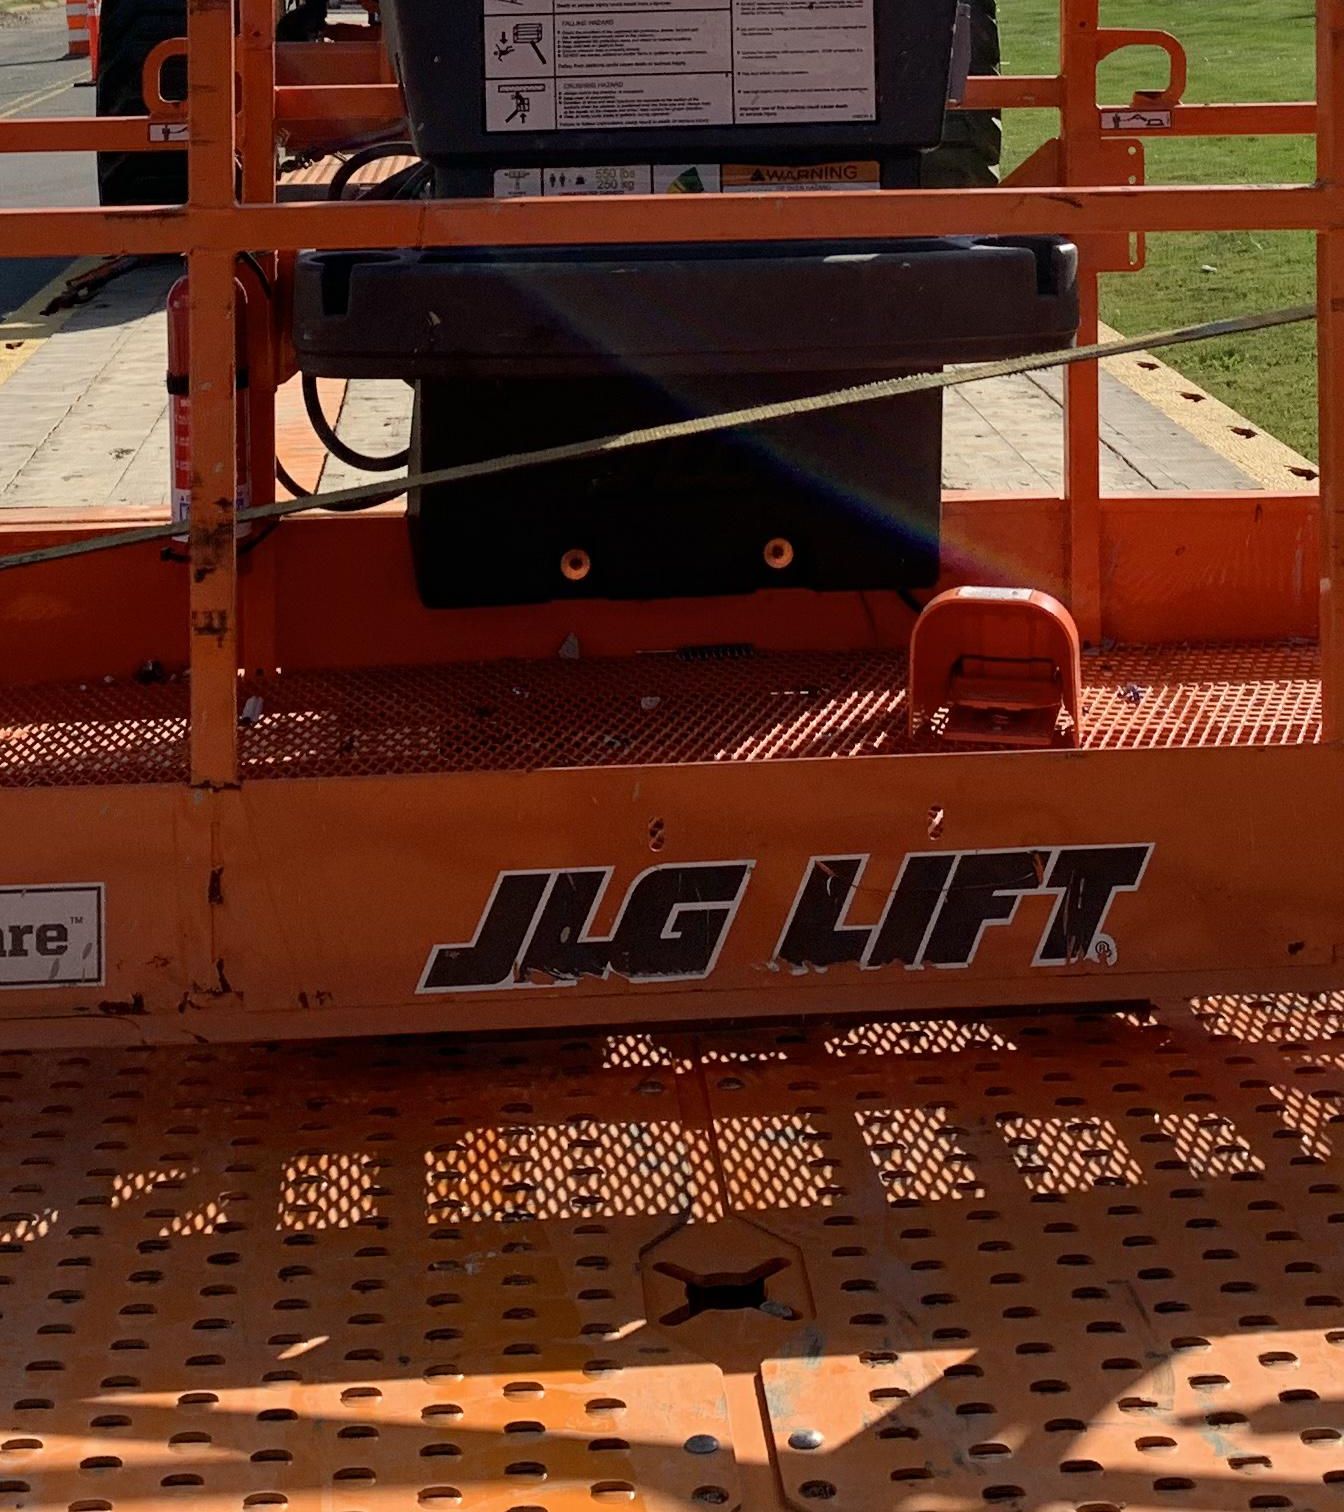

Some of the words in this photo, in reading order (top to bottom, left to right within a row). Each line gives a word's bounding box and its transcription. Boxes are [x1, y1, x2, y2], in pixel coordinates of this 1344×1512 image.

[596, 169, 616, 179] 550
[767, 165, 858, 181] WARNING
[597, 179, 617, 189] 250
[414, 859, 757, 995] JLG
[773, 842, 1157, 975] LIFT
